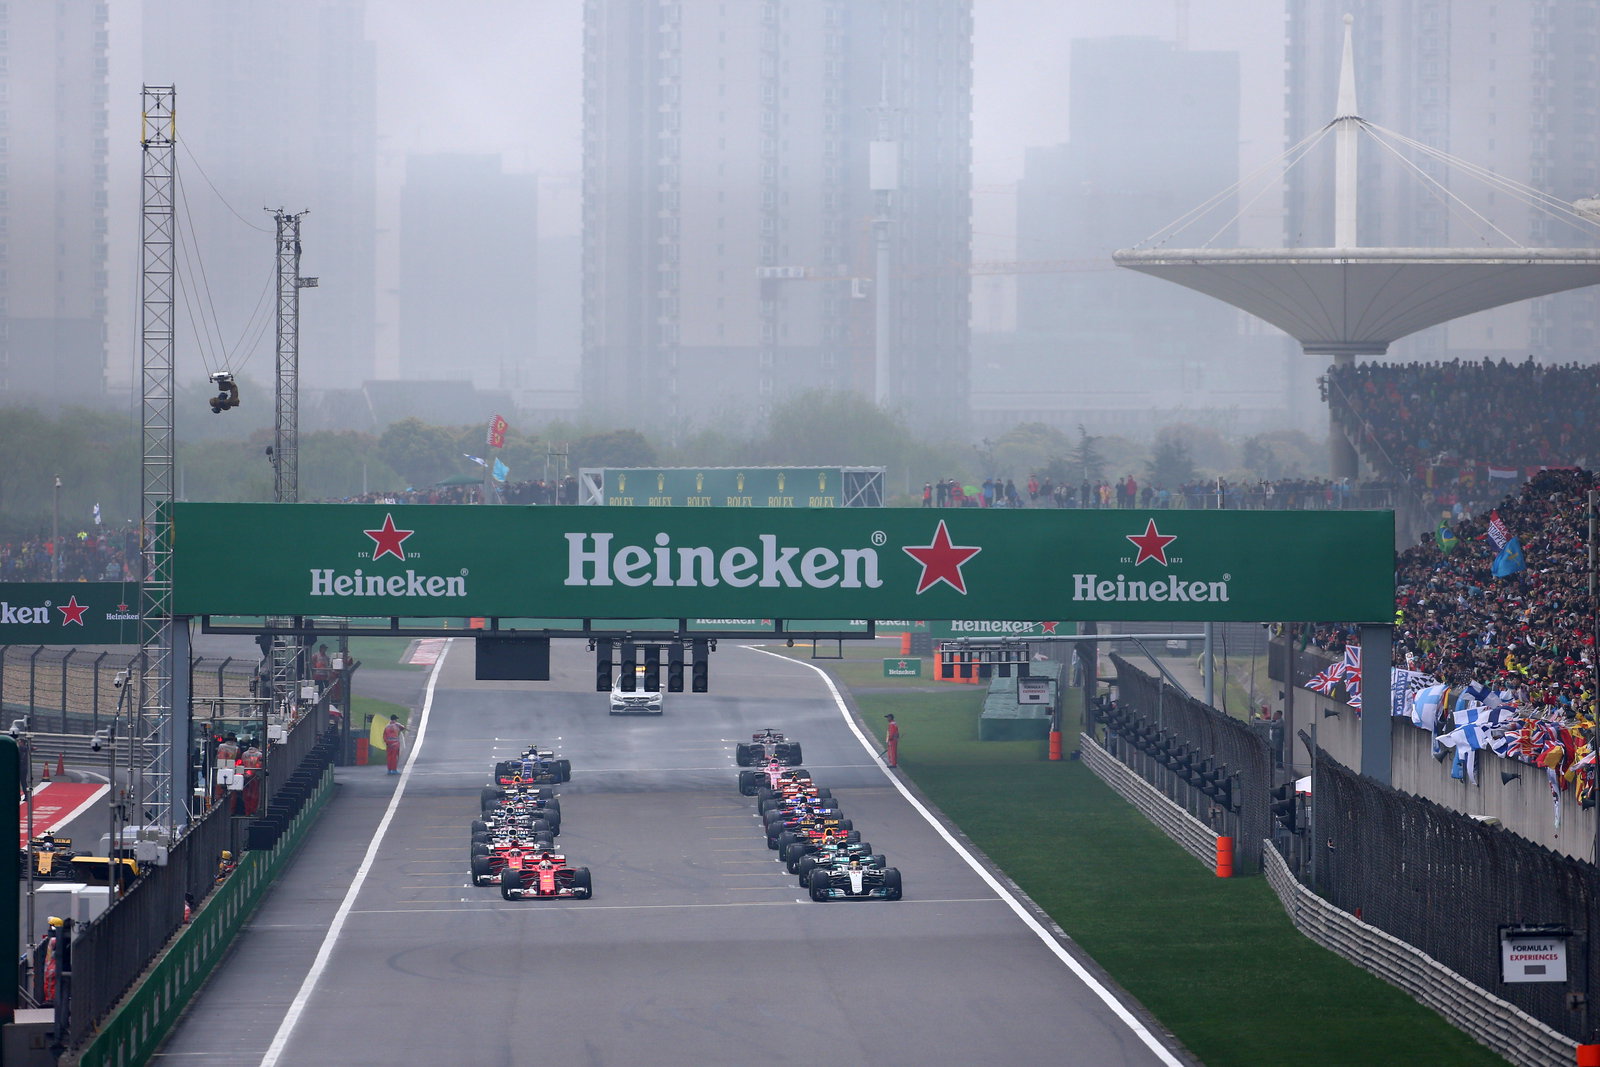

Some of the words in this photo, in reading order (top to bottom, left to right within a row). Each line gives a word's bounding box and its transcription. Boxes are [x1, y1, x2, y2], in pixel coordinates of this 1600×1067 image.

[563, 532, 884, 589] Heineken
[310, 568, 468, 597] Heineken
[1072, 573, 1230, 602] Heineken
[950, 620, 1034, 632] Heineken
[1509, 953, 1559, 962] EXPERIENCES
[1512, 944, 1548, 952] FORMULA
